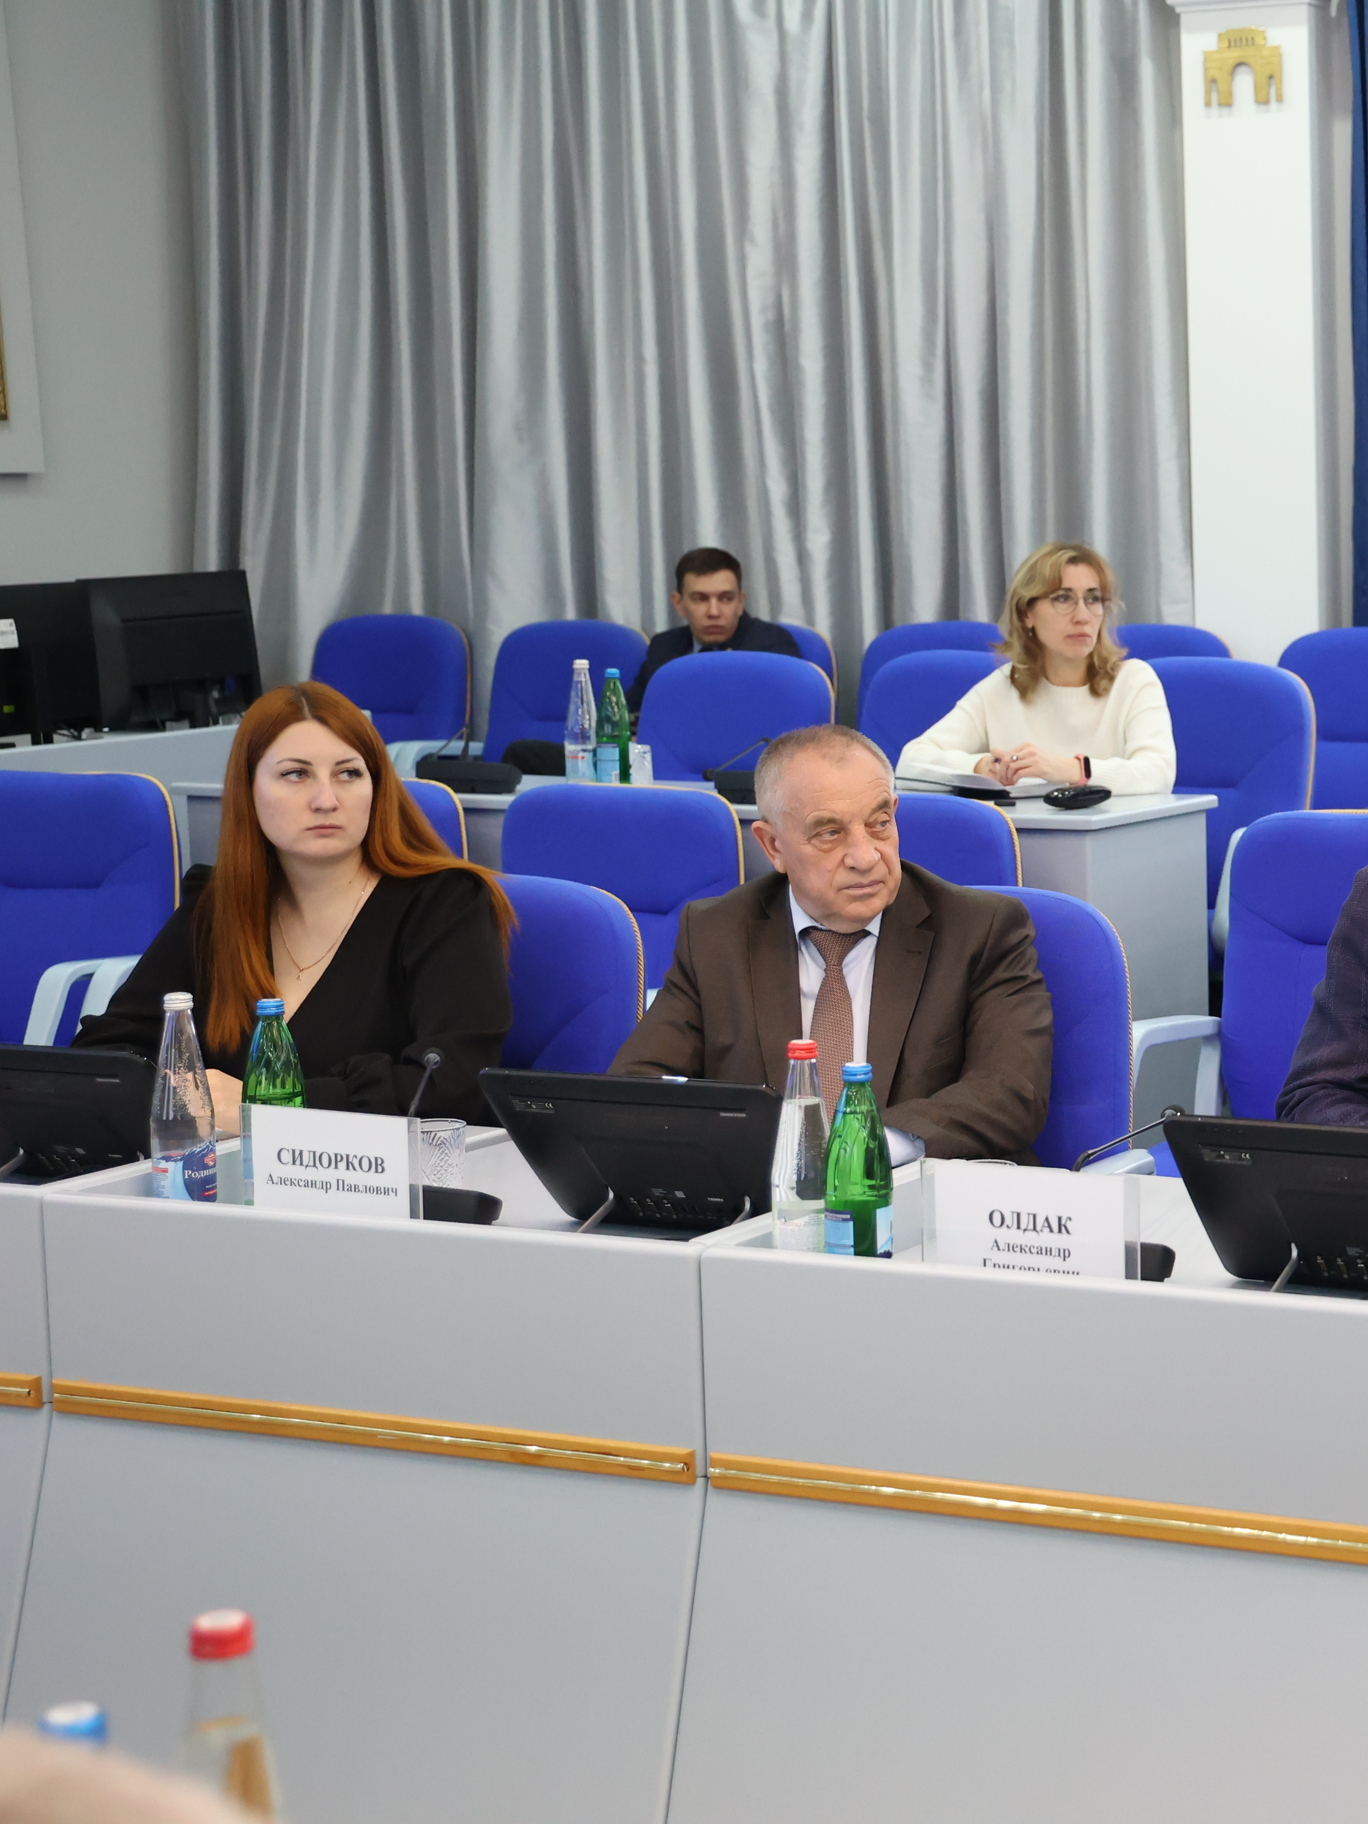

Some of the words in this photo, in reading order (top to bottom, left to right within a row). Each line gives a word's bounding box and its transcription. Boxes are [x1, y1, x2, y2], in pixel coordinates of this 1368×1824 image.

[276, 1147, 386, 1174] СИДОРКОВ
[266, 1173, 332, 1193] Александр
[335, 1178, 398, 1197] Павлович
[988, 1208, 1072, 1236] ОЛДАК
[990, 1237, 1071, 1261] Александр
